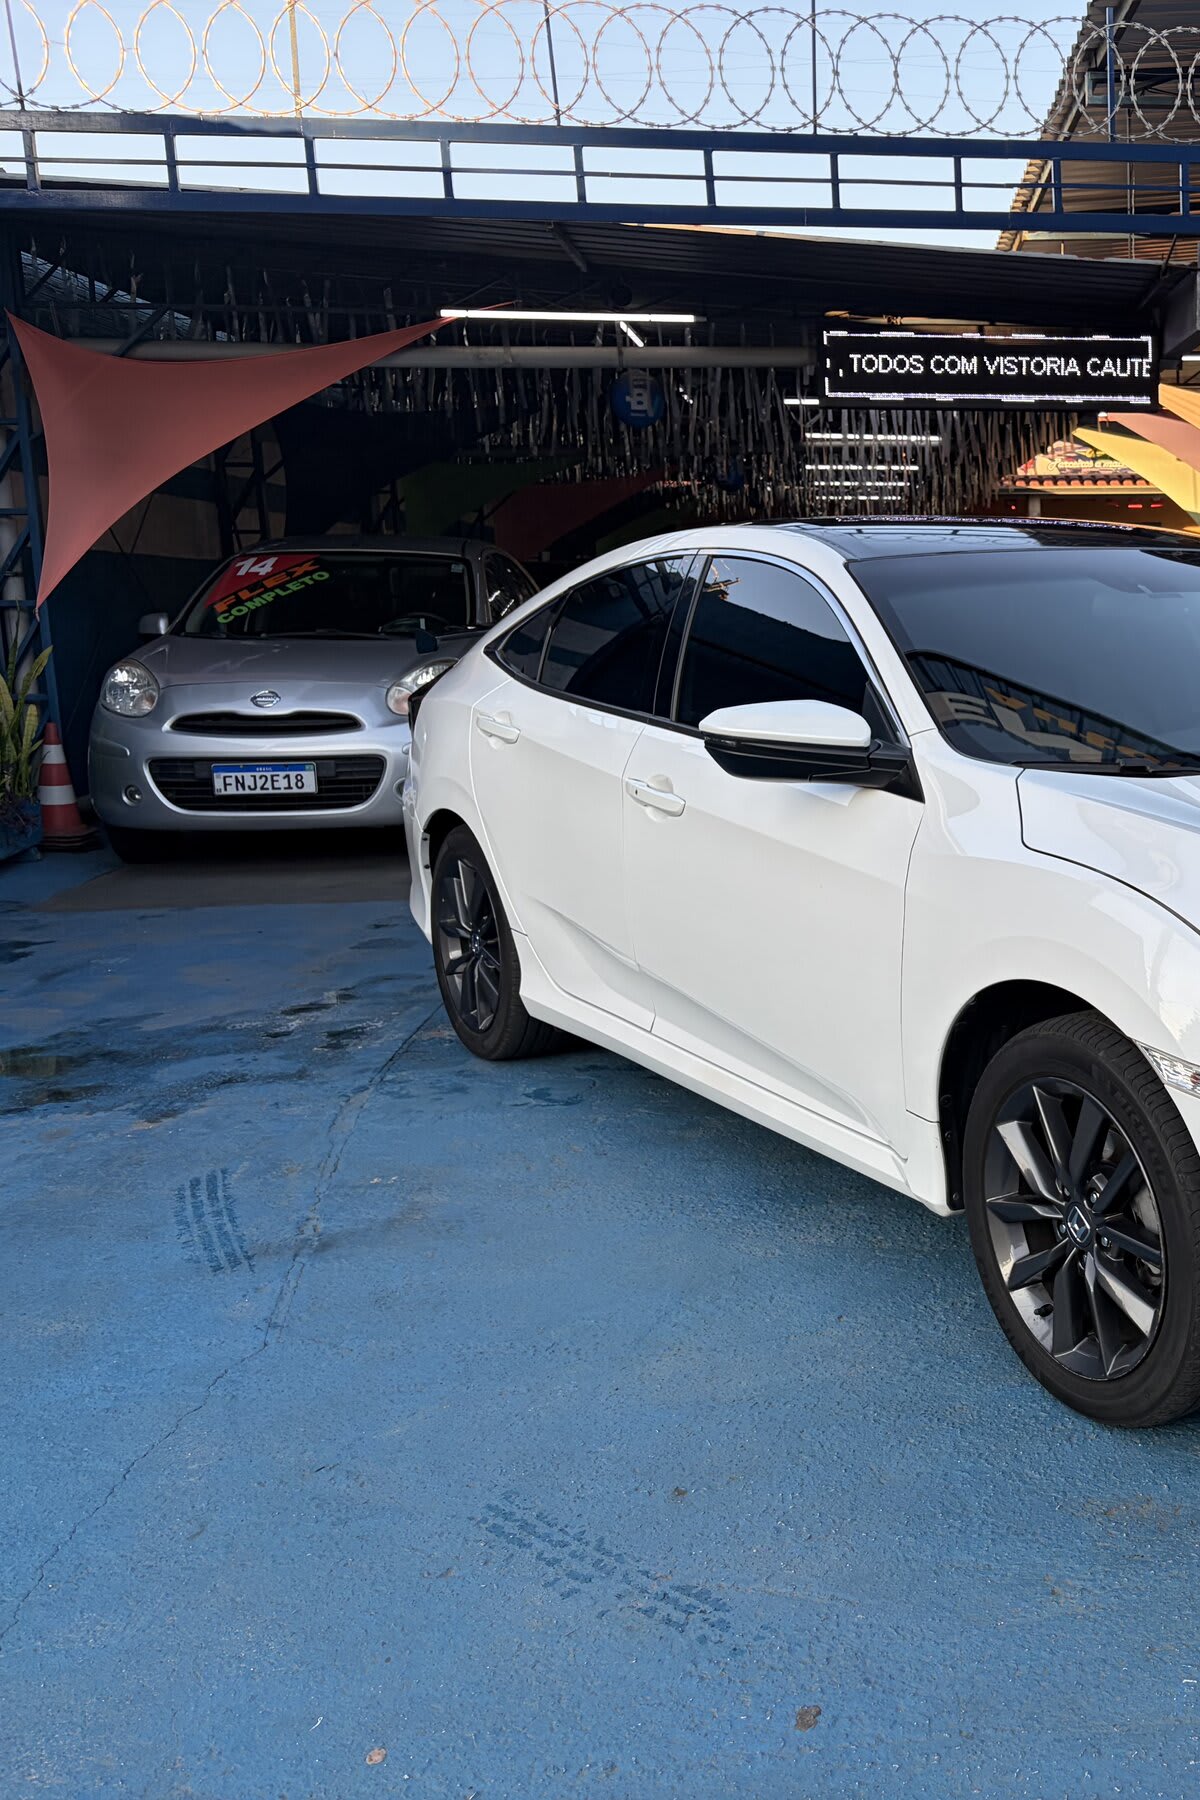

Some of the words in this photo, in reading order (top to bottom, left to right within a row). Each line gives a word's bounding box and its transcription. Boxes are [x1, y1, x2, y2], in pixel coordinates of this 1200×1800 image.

[849, 354, 924, 374] TODOS
[930, 355, 978, 375] COM
[983, 356, 1081, 376] VISTORIA
[1086, 358, 1151, 377] CAUTE
[234, 556, 279, 576] 14
[213, 560, 320, 613] FLEX
[217, 571, 329, 623] COMPLETO
[222, 773, 305, 792] FNJ2E18
